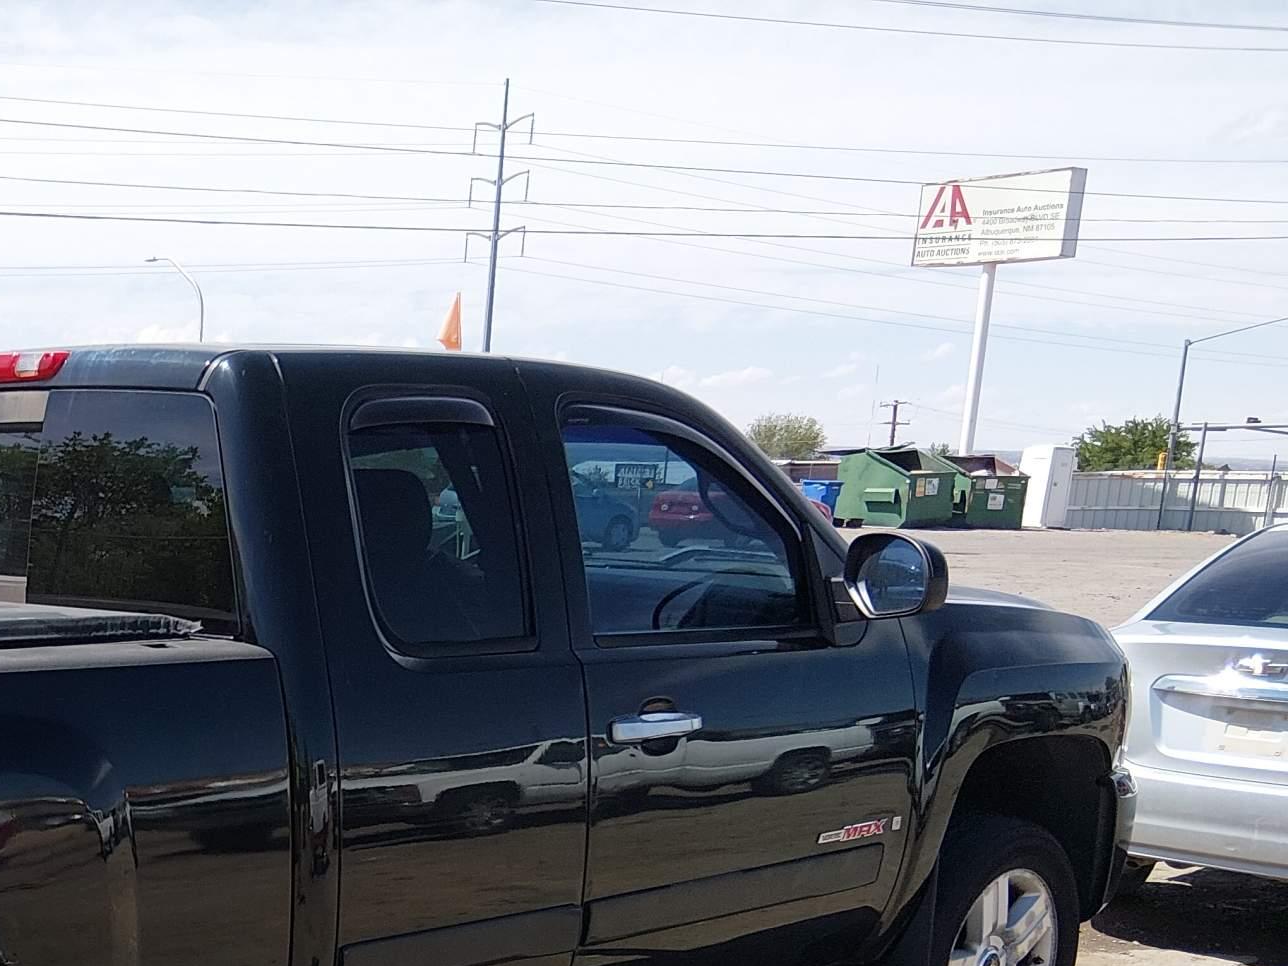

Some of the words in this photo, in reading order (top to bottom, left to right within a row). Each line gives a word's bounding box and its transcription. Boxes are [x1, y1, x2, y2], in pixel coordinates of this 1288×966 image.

[982, 207, 1015, 216] Insurance
[1016, 205, 1032, 213] Auto
[1033, 201, 1064, 211] Auctions
[917, 233, 972, 246] INSURANCE
[915, 249, 935, 258] AUTO
[935, 246, 970, 257] AUCTIONS
[841, 818, 888, 841] MAX
